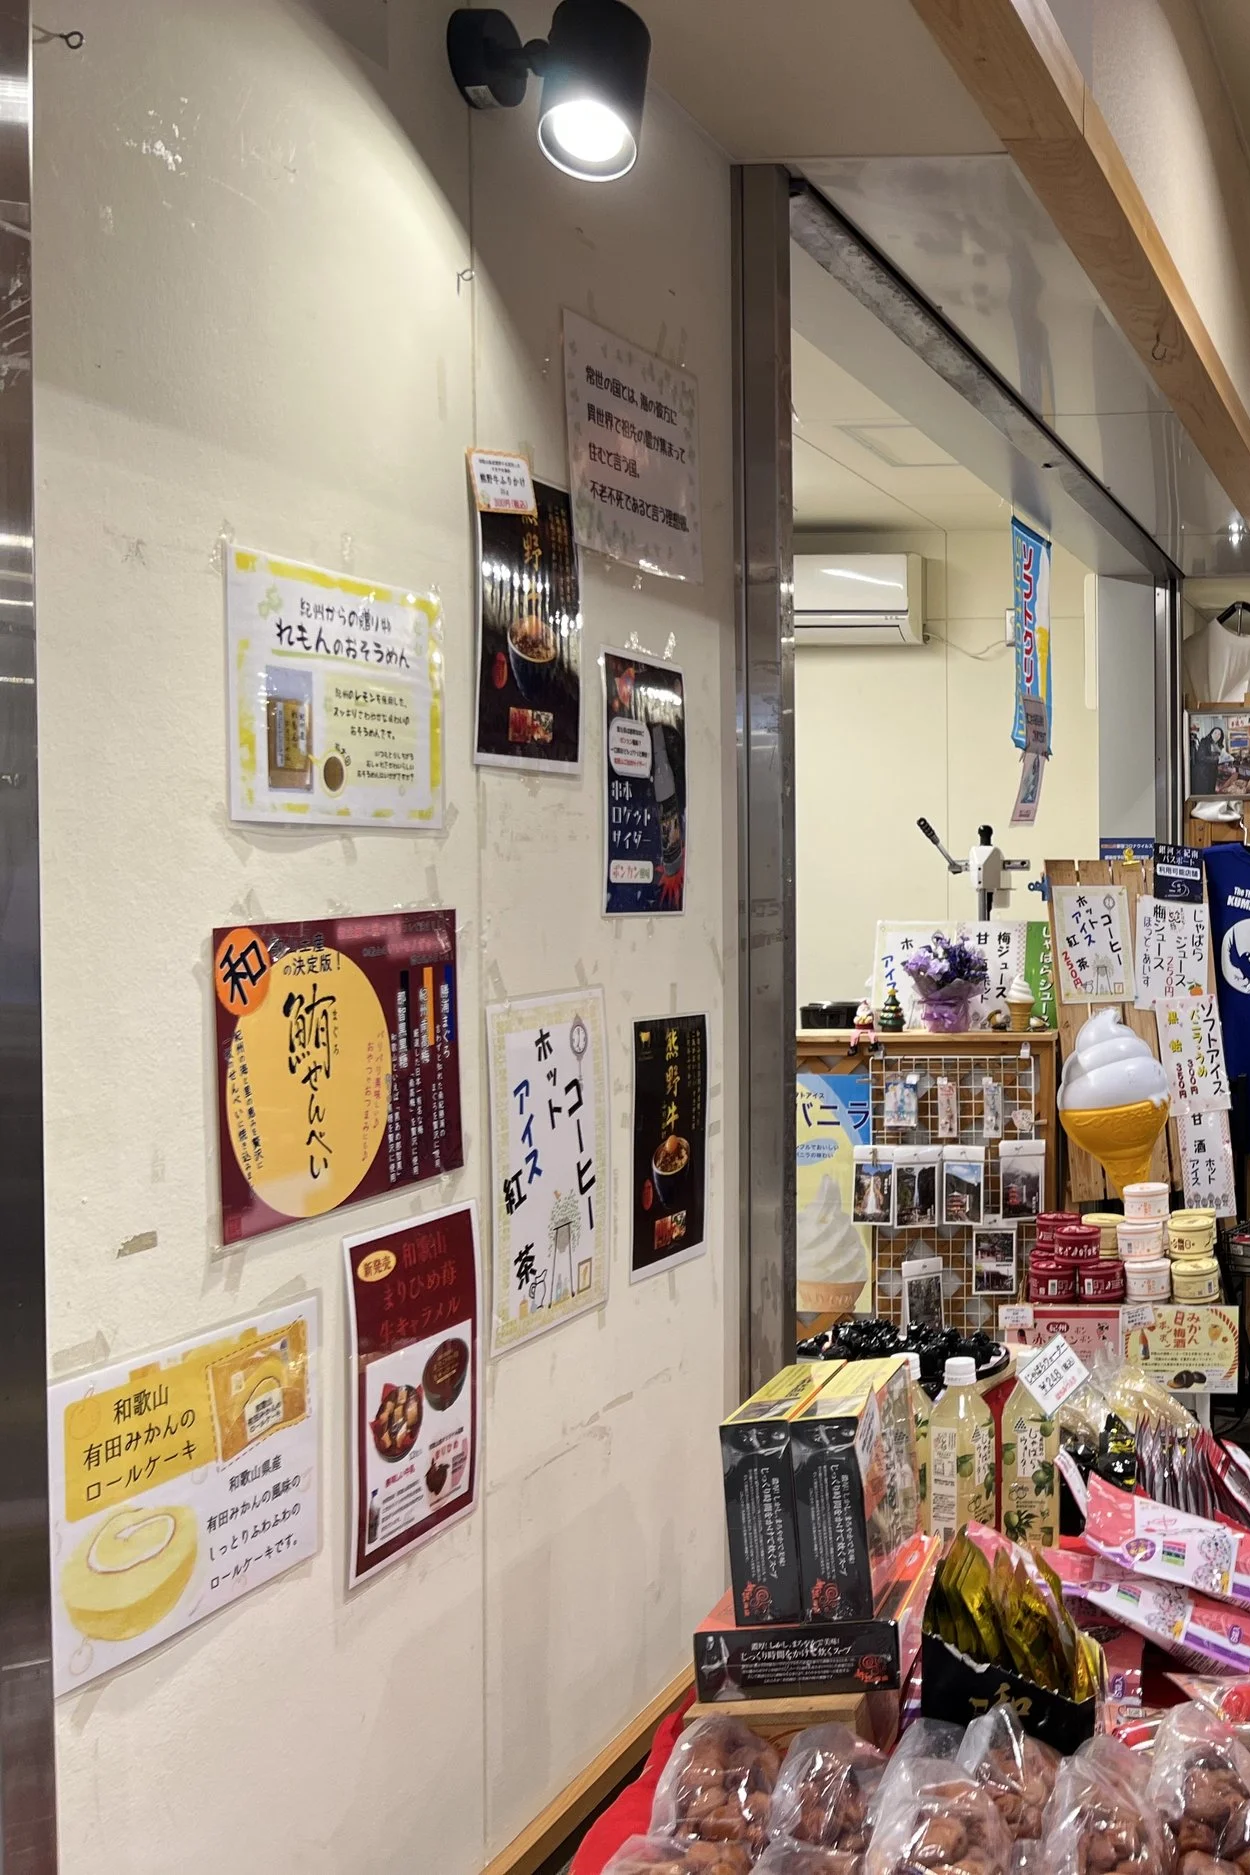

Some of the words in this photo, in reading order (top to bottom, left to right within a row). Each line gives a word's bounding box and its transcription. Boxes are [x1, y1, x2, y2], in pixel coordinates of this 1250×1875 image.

[276, 618, 409, 669] れもんのおそうめん
[611, 780, 633, 800] 串本
[612, 806, 651, 827] ロケット
[612, 830, 652, 850] サイダー
[1159, 867, 1199, 878] 利用可能店舗
[1162, 855, 1195, 866] パスポート
[1076, 895, 1099, 931] ホット
[1234, 886, 1244, 896] The
[1065, 934, 1091, 972] 紅茶
[1071, 911, 1097, 948] アイス
[1100, 913, 1123, 967] コーヒー
[1152, 903, 1167, 971] 梅ジュース
[1191, 908, 1205, 963] じゃばら
[219, 940, 266, 1005] 和
[996, 932, 1011, 1000] 梅ジュース
[1061, 950, 1084, 990] 250円
[1164, 955, 1174, 998] 250円
[1175, 935, 1188, 988] ジュース
[1200, 1003, 1226, 1097] ソフトアイス
[283, 983, 337, 1180] 鮪せんべい
[534, 1028, 563, 1130] ホット
[665, 1027, 681, 1132] 熊野牛
[1176, 1062, 1188, 1100] 350円
[1187, 1058, 1199, 1096] 300円
[512, 1079, 544, 1185] アイス
[564, 1078, 597, 1231] コーヒー
[1190, 1112, 1207, 1155] 甘酒
[1189, 1158, 1201, 1187] アイス
[1205, 1157, 1217, 1184] ホット
[402, 1231, 448, 1269] 和歌山
[502, 1169, 538, 1290] 紅茶
[114, 1382, 170, 1425] 和歌山
[83, 1408, 196, 1472] 有田みかんの
[86, 1439, 197, 1501] ロールケーキ
[229, 1454, 283, 1493] 和歌山県産
[206, 1474, 301, 1534] 有田みかんの風味の
[209, 1503, 301, 1561] しっとりふわふわの
[210, 1533, 298, 1590] ロールケーキです。
